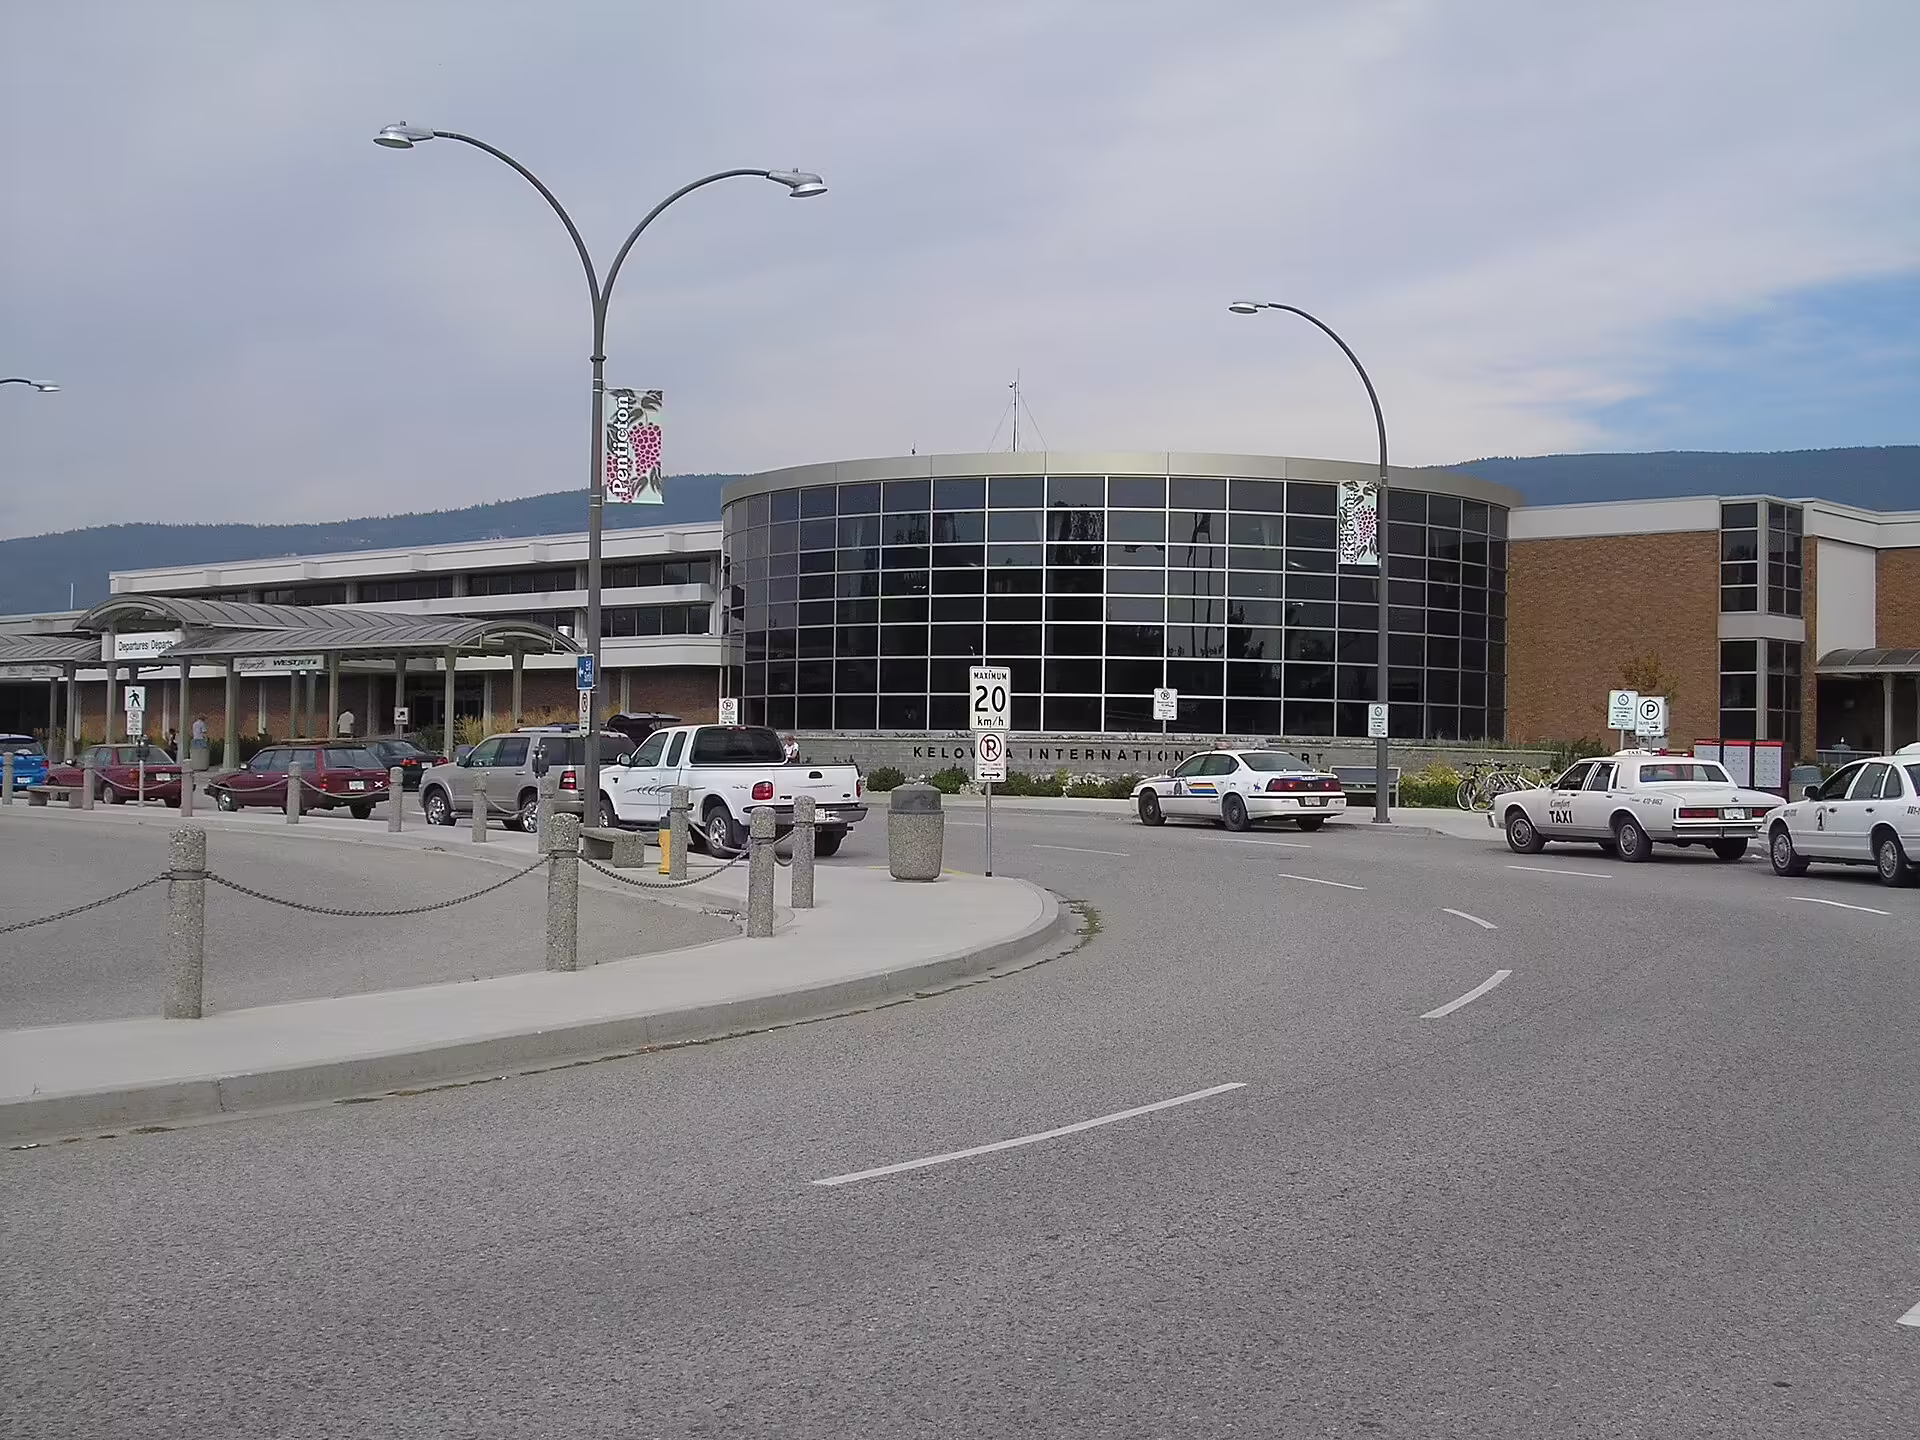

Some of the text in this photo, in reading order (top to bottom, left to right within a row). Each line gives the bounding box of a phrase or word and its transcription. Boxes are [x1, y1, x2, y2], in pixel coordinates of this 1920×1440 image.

[612, 396, 629, 494] Penticton
[1343, 490, 1356, 558] Kelowna
[118, 641, 149, 653] Departures
[973, 671, 1007, 681] MAXIMUM
[974, 684, 1007, 713] 20
[977, 715, 1004, 728] km/h
[913, 746, 1200, 763] KELOA INTERNATION
[1549, 810, 1573, 824] TAXI
